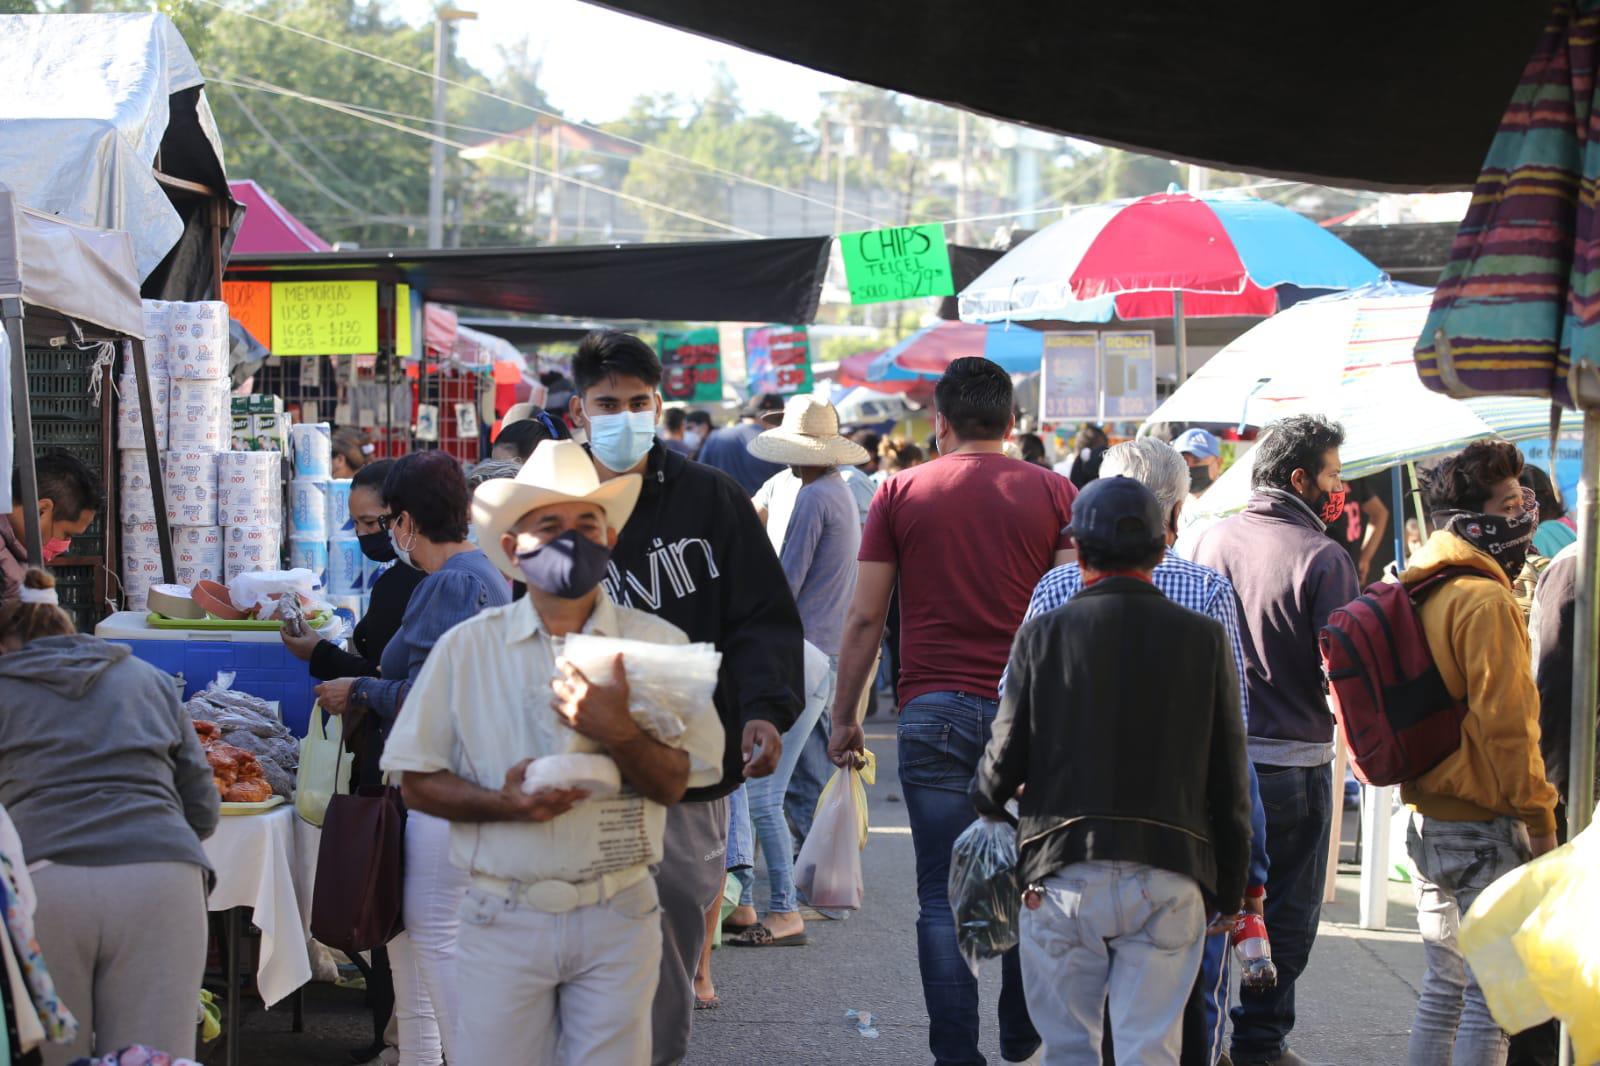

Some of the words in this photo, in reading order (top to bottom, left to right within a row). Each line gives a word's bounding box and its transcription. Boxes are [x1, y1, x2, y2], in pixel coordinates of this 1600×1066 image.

[860, 226, 930, 262] CHIPS
[865, 257, 924, 277] TELCEL
[285, 284, 352, 300] MEMORIAS
[281, 304, 311, 320] USB
[327, 303, 347, 318] SD
[231, 476, 245, 484] 600
[233, 515, 248, 523] 600
[205, 535, 218, 543] 600
[248, 532, 262, 540] 600
[180, 554, 193, 562] 600
